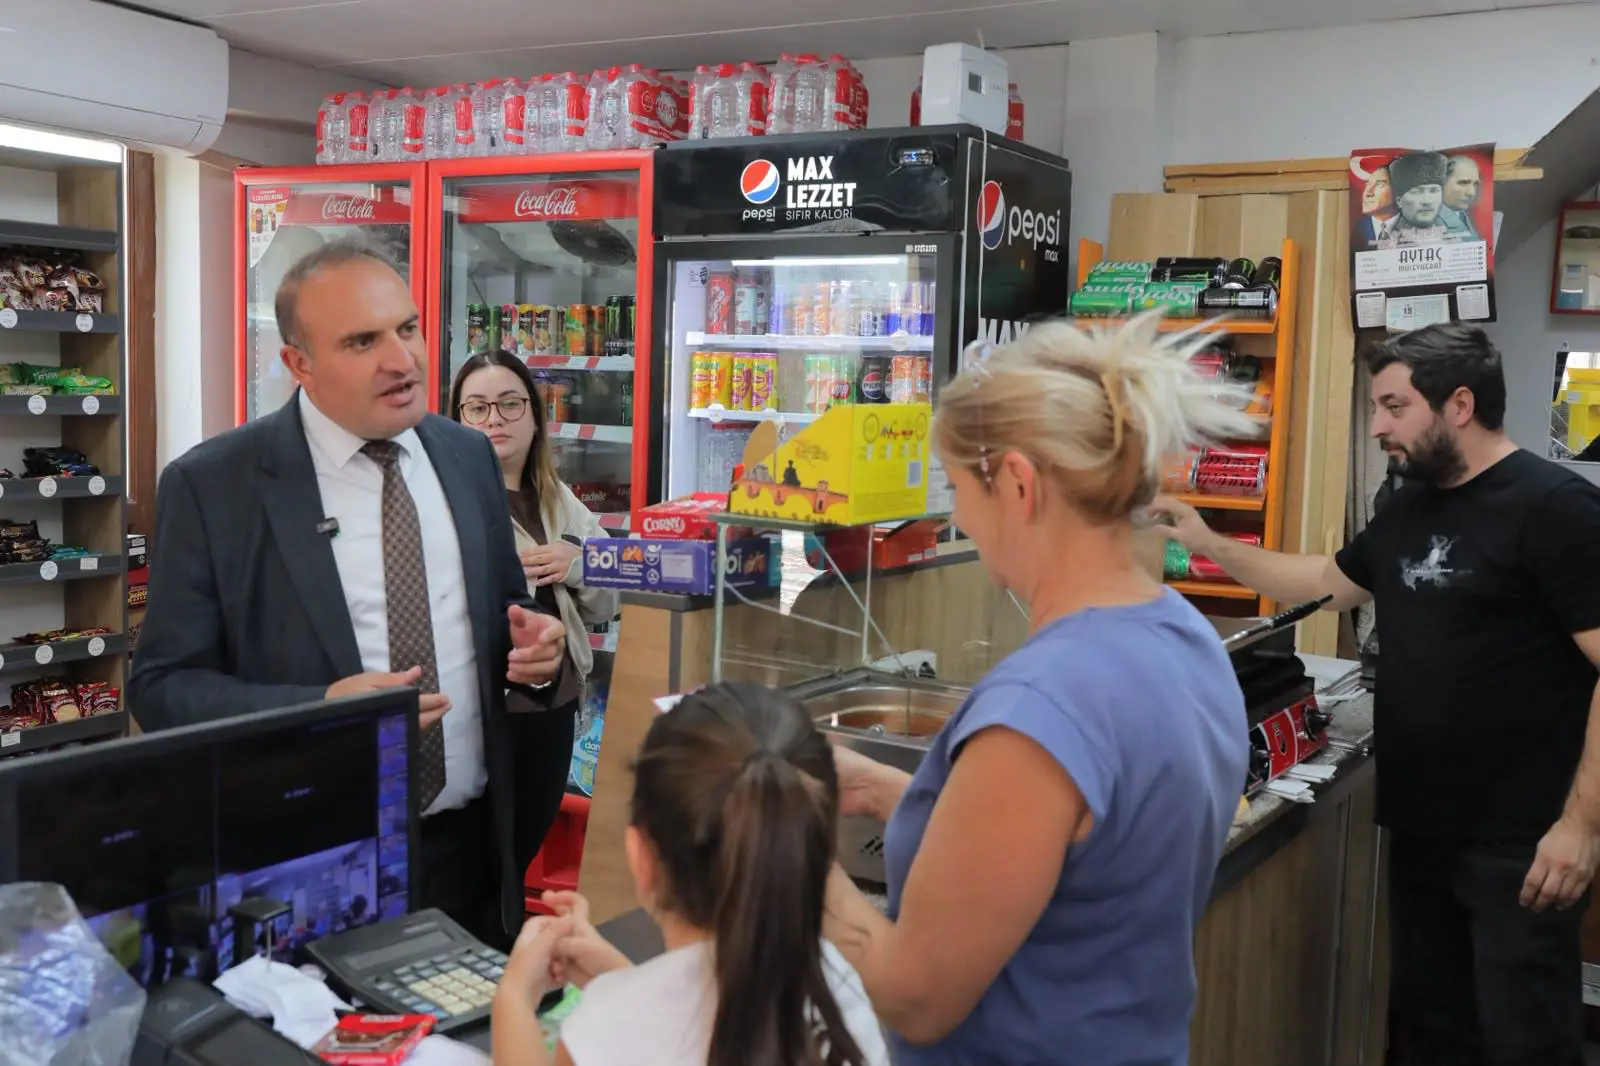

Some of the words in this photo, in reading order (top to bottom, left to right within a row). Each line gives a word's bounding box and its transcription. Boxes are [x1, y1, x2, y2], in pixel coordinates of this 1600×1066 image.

[787, 156, 834, 181] MAX
[786, 183, 857, 209] LEZZET
[742, 206, 776, 221] pepsi
[786, 209, 812, 221] SIFIR
[1008, 205, 1061, 251] pepsi
[1045, 249, 1059, 262] max
